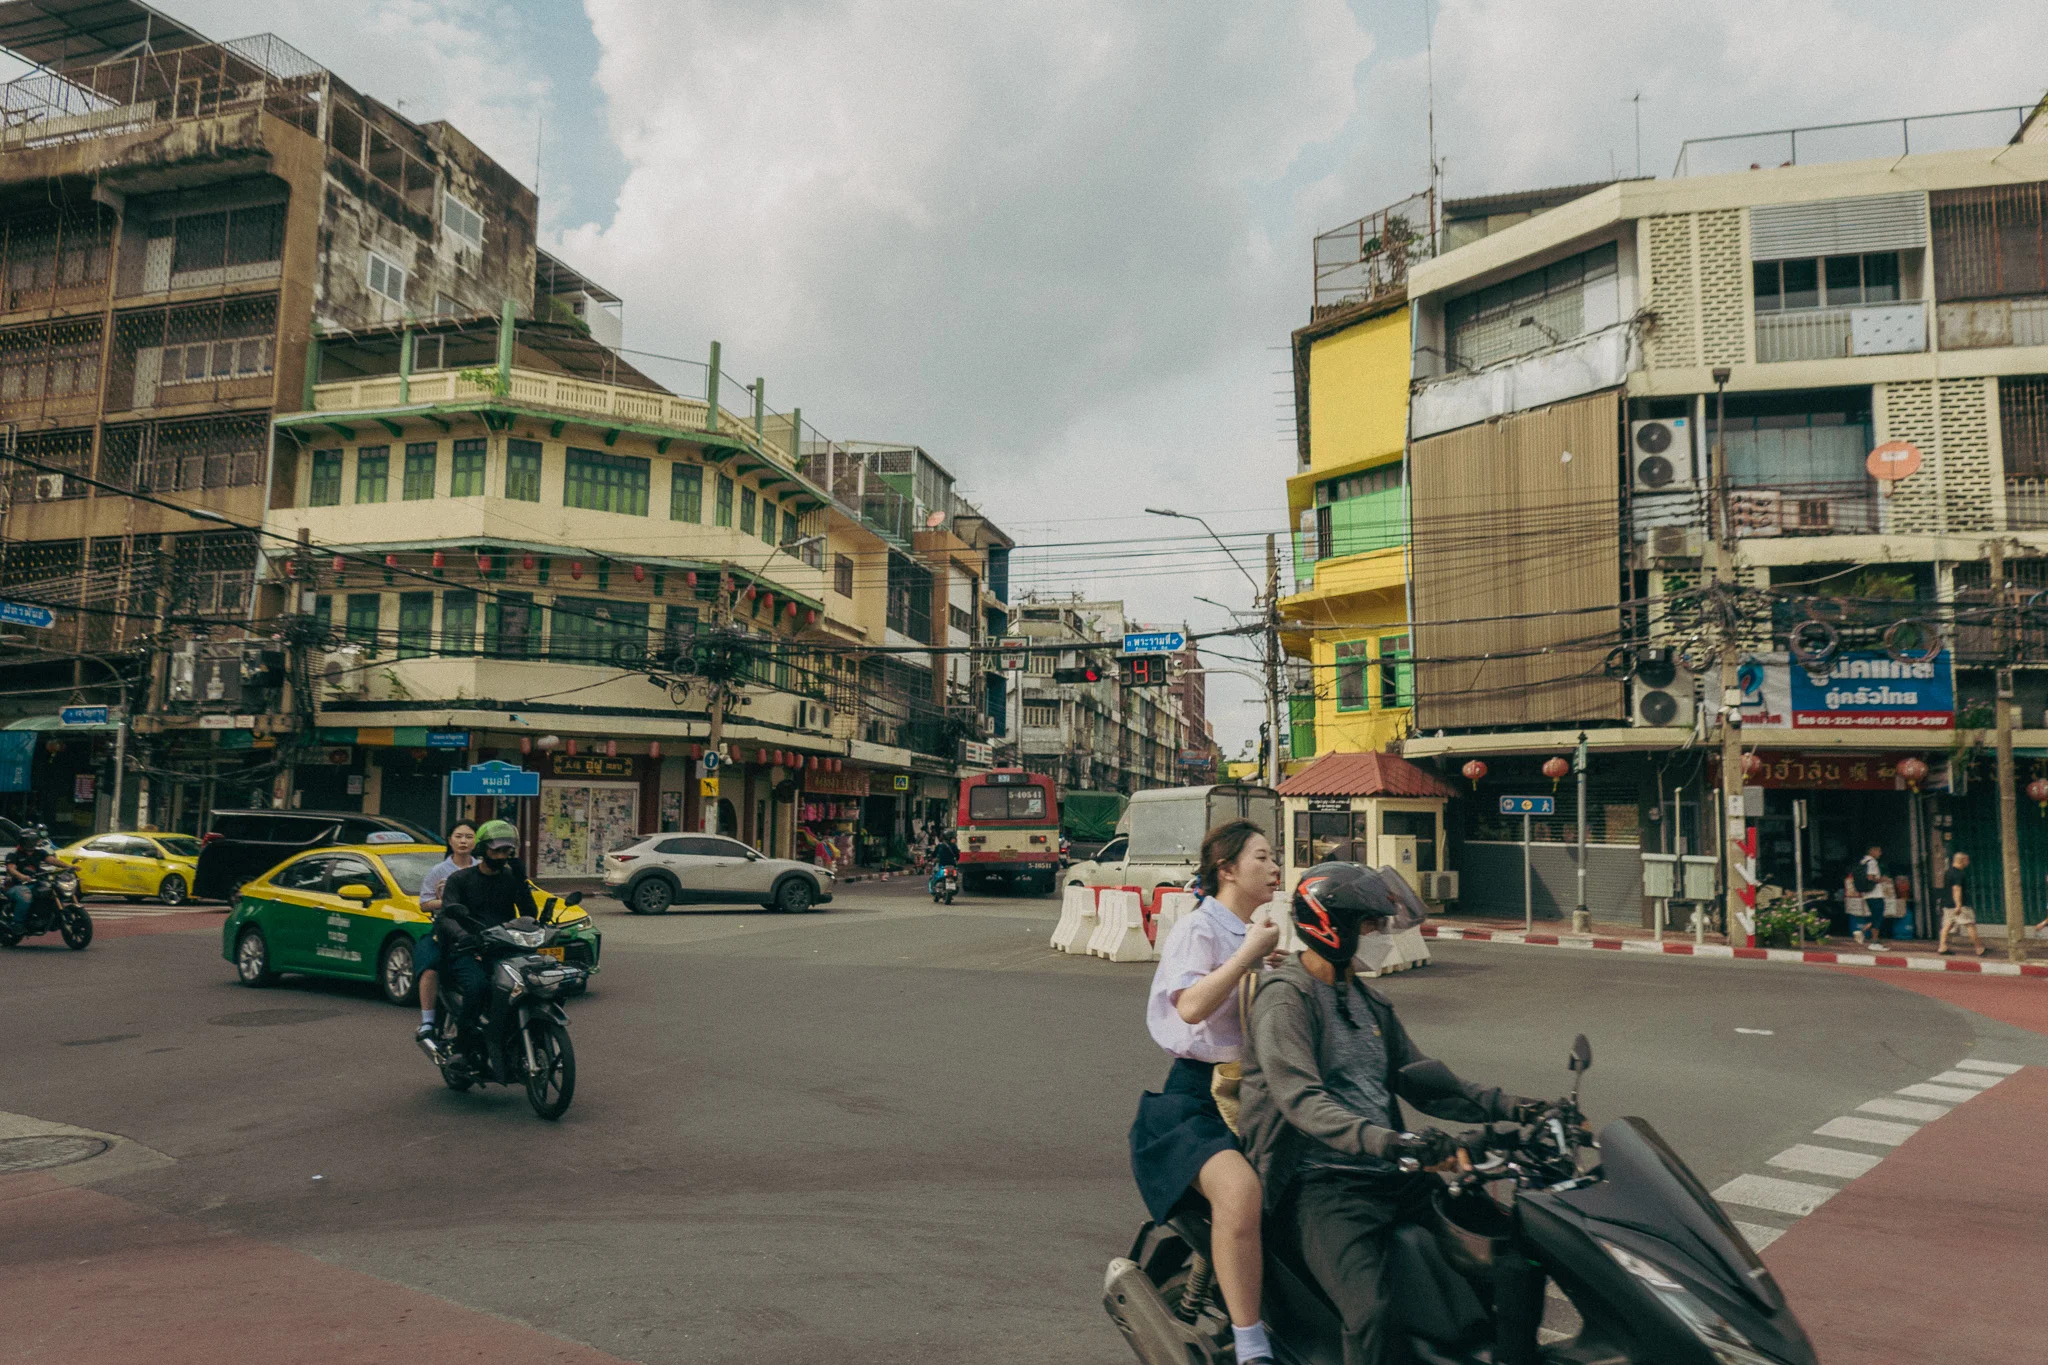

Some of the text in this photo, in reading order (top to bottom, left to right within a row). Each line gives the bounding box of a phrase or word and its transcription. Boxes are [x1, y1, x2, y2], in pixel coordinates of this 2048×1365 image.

[1133, 659, 1148, 683] 4
[1825, 686, 1918, 710] คู่ครัวไทย
[482, 774, 511, 786] หมอมี
